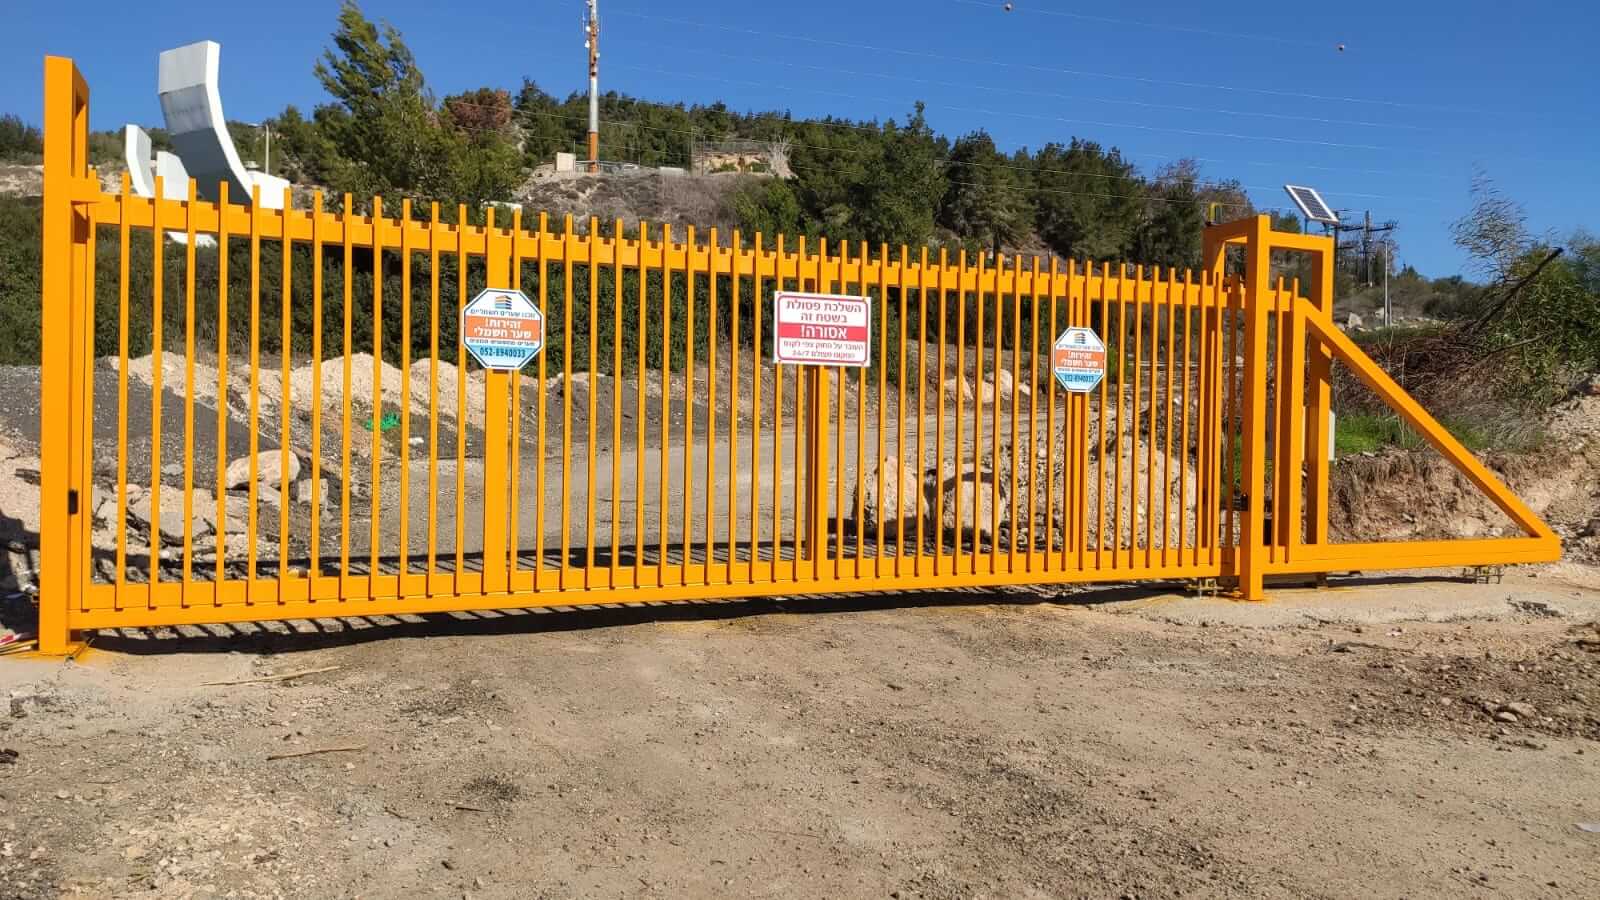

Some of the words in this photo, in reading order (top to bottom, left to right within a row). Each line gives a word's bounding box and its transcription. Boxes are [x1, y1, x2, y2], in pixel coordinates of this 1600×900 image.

[786, 299, 821, 311] פסולת
[824, 302, 862, 312] השלכת
[800, 312, 814, 321] זה
[816, 313, 848, 323] בשטח
[485, 317, 522, 328] זהירות!
[473, 326, 508, 337] חשמלי
[511, 330, 532, 339] שער
[800, 325, 848, 339] אסורה!
[833, 341, 843, 349] על
